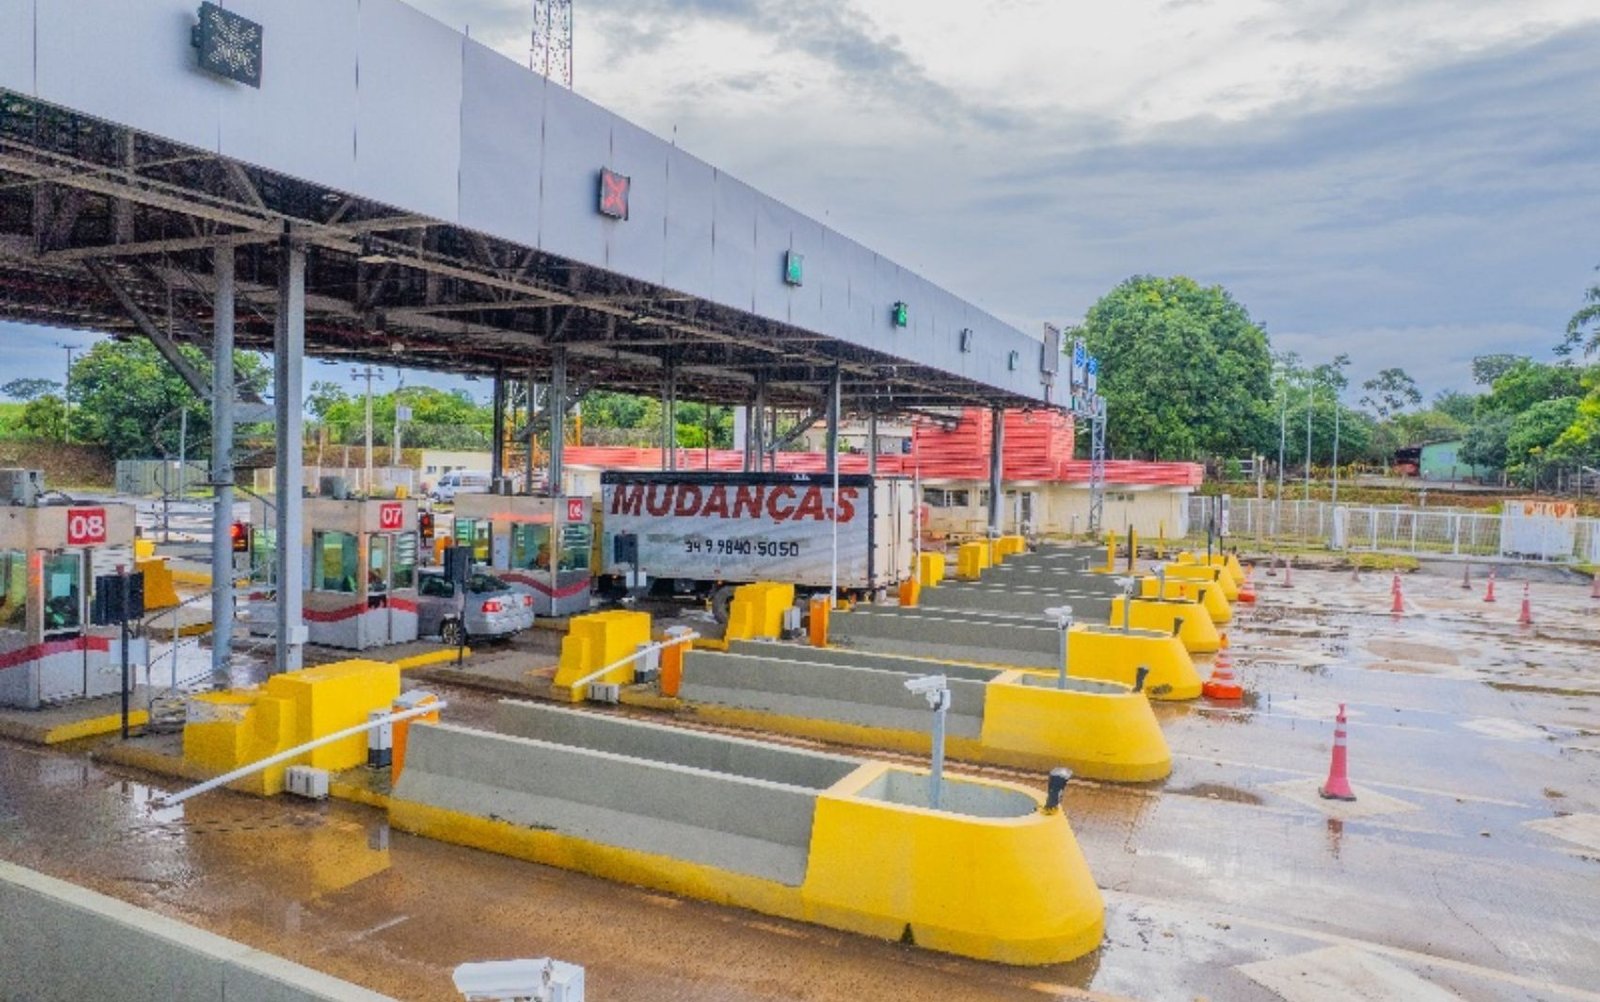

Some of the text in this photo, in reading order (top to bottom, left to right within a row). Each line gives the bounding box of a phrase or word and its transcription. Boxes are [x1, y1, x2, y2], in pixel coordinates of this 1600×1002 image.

[382, 507, 401, 525] 07
[70, 515, 104, 539] 08
[685, 540, 701, 553] 34
[706, 539, 713, 553] 9
